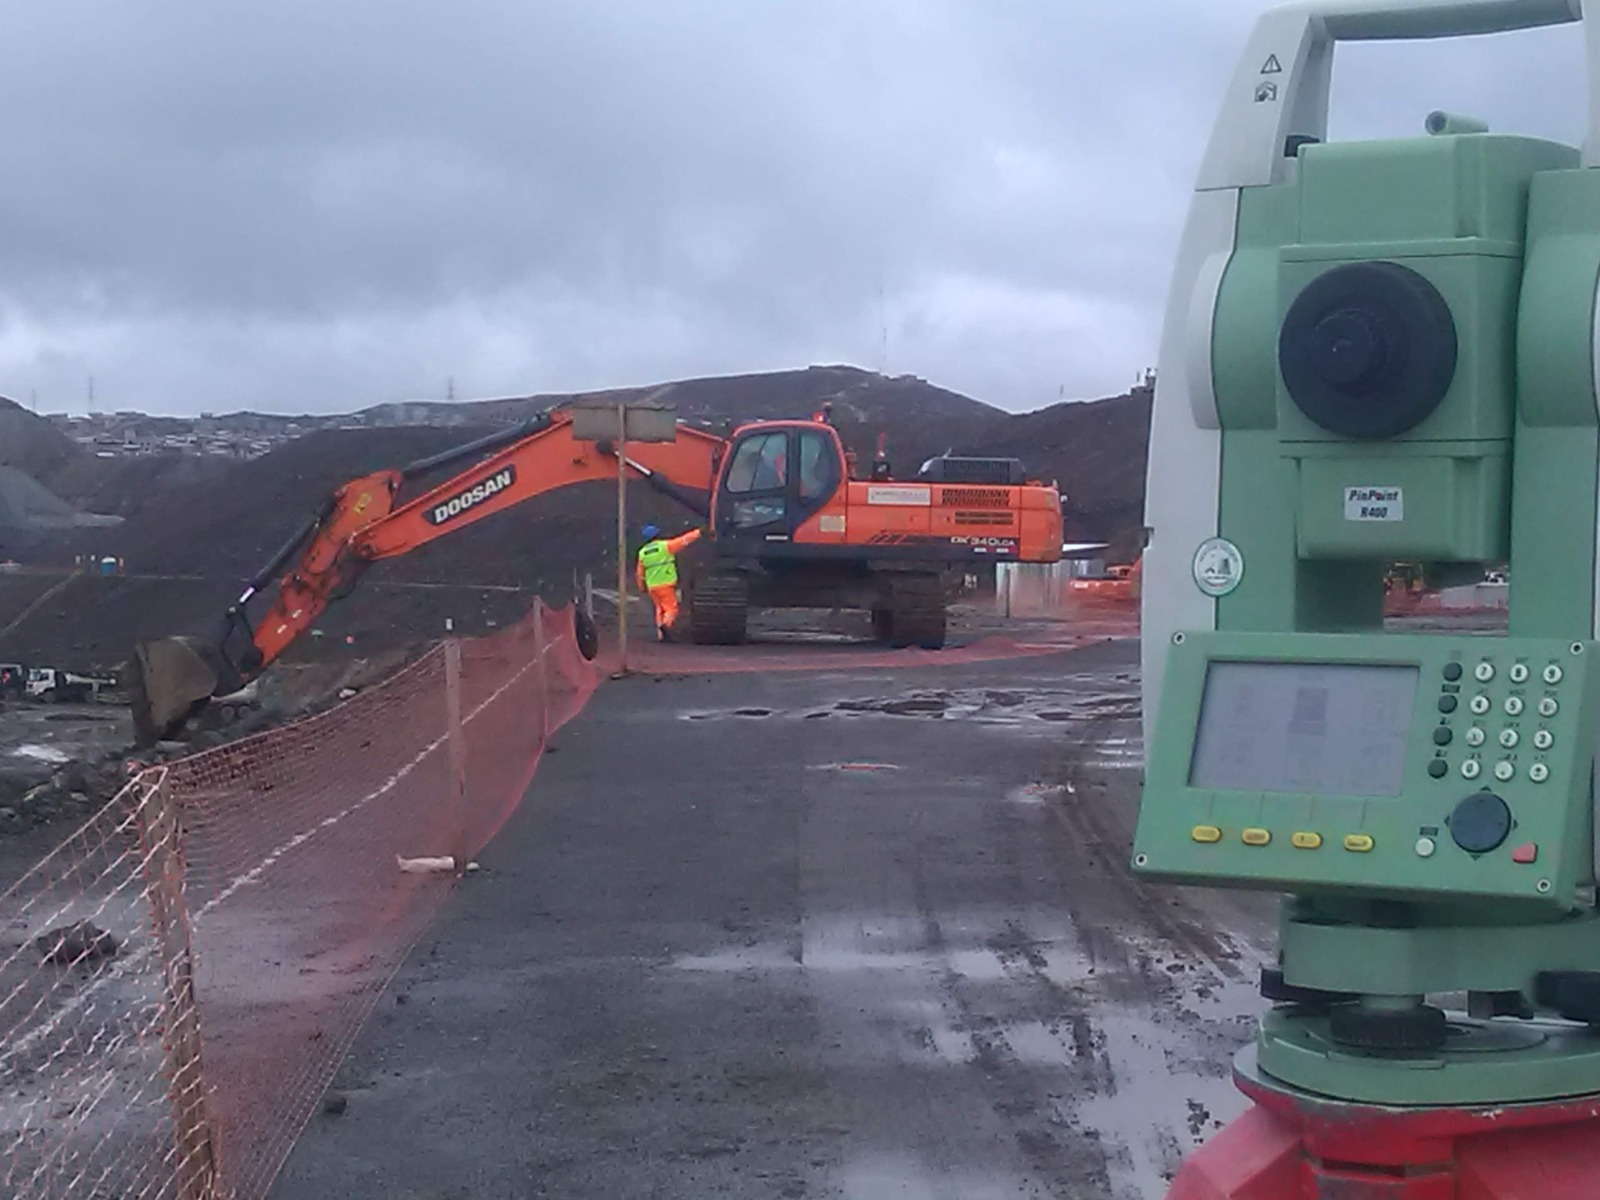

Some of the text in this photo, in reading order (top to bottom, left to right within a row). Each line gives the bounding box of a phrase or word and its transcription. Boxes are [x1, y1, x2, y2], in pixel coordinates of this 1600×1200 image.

[434, 470, 511, 524] DOOSAN
[1349, 489, 1399, 501] PinPoint
[1360, 506, 1388, 519] R400
